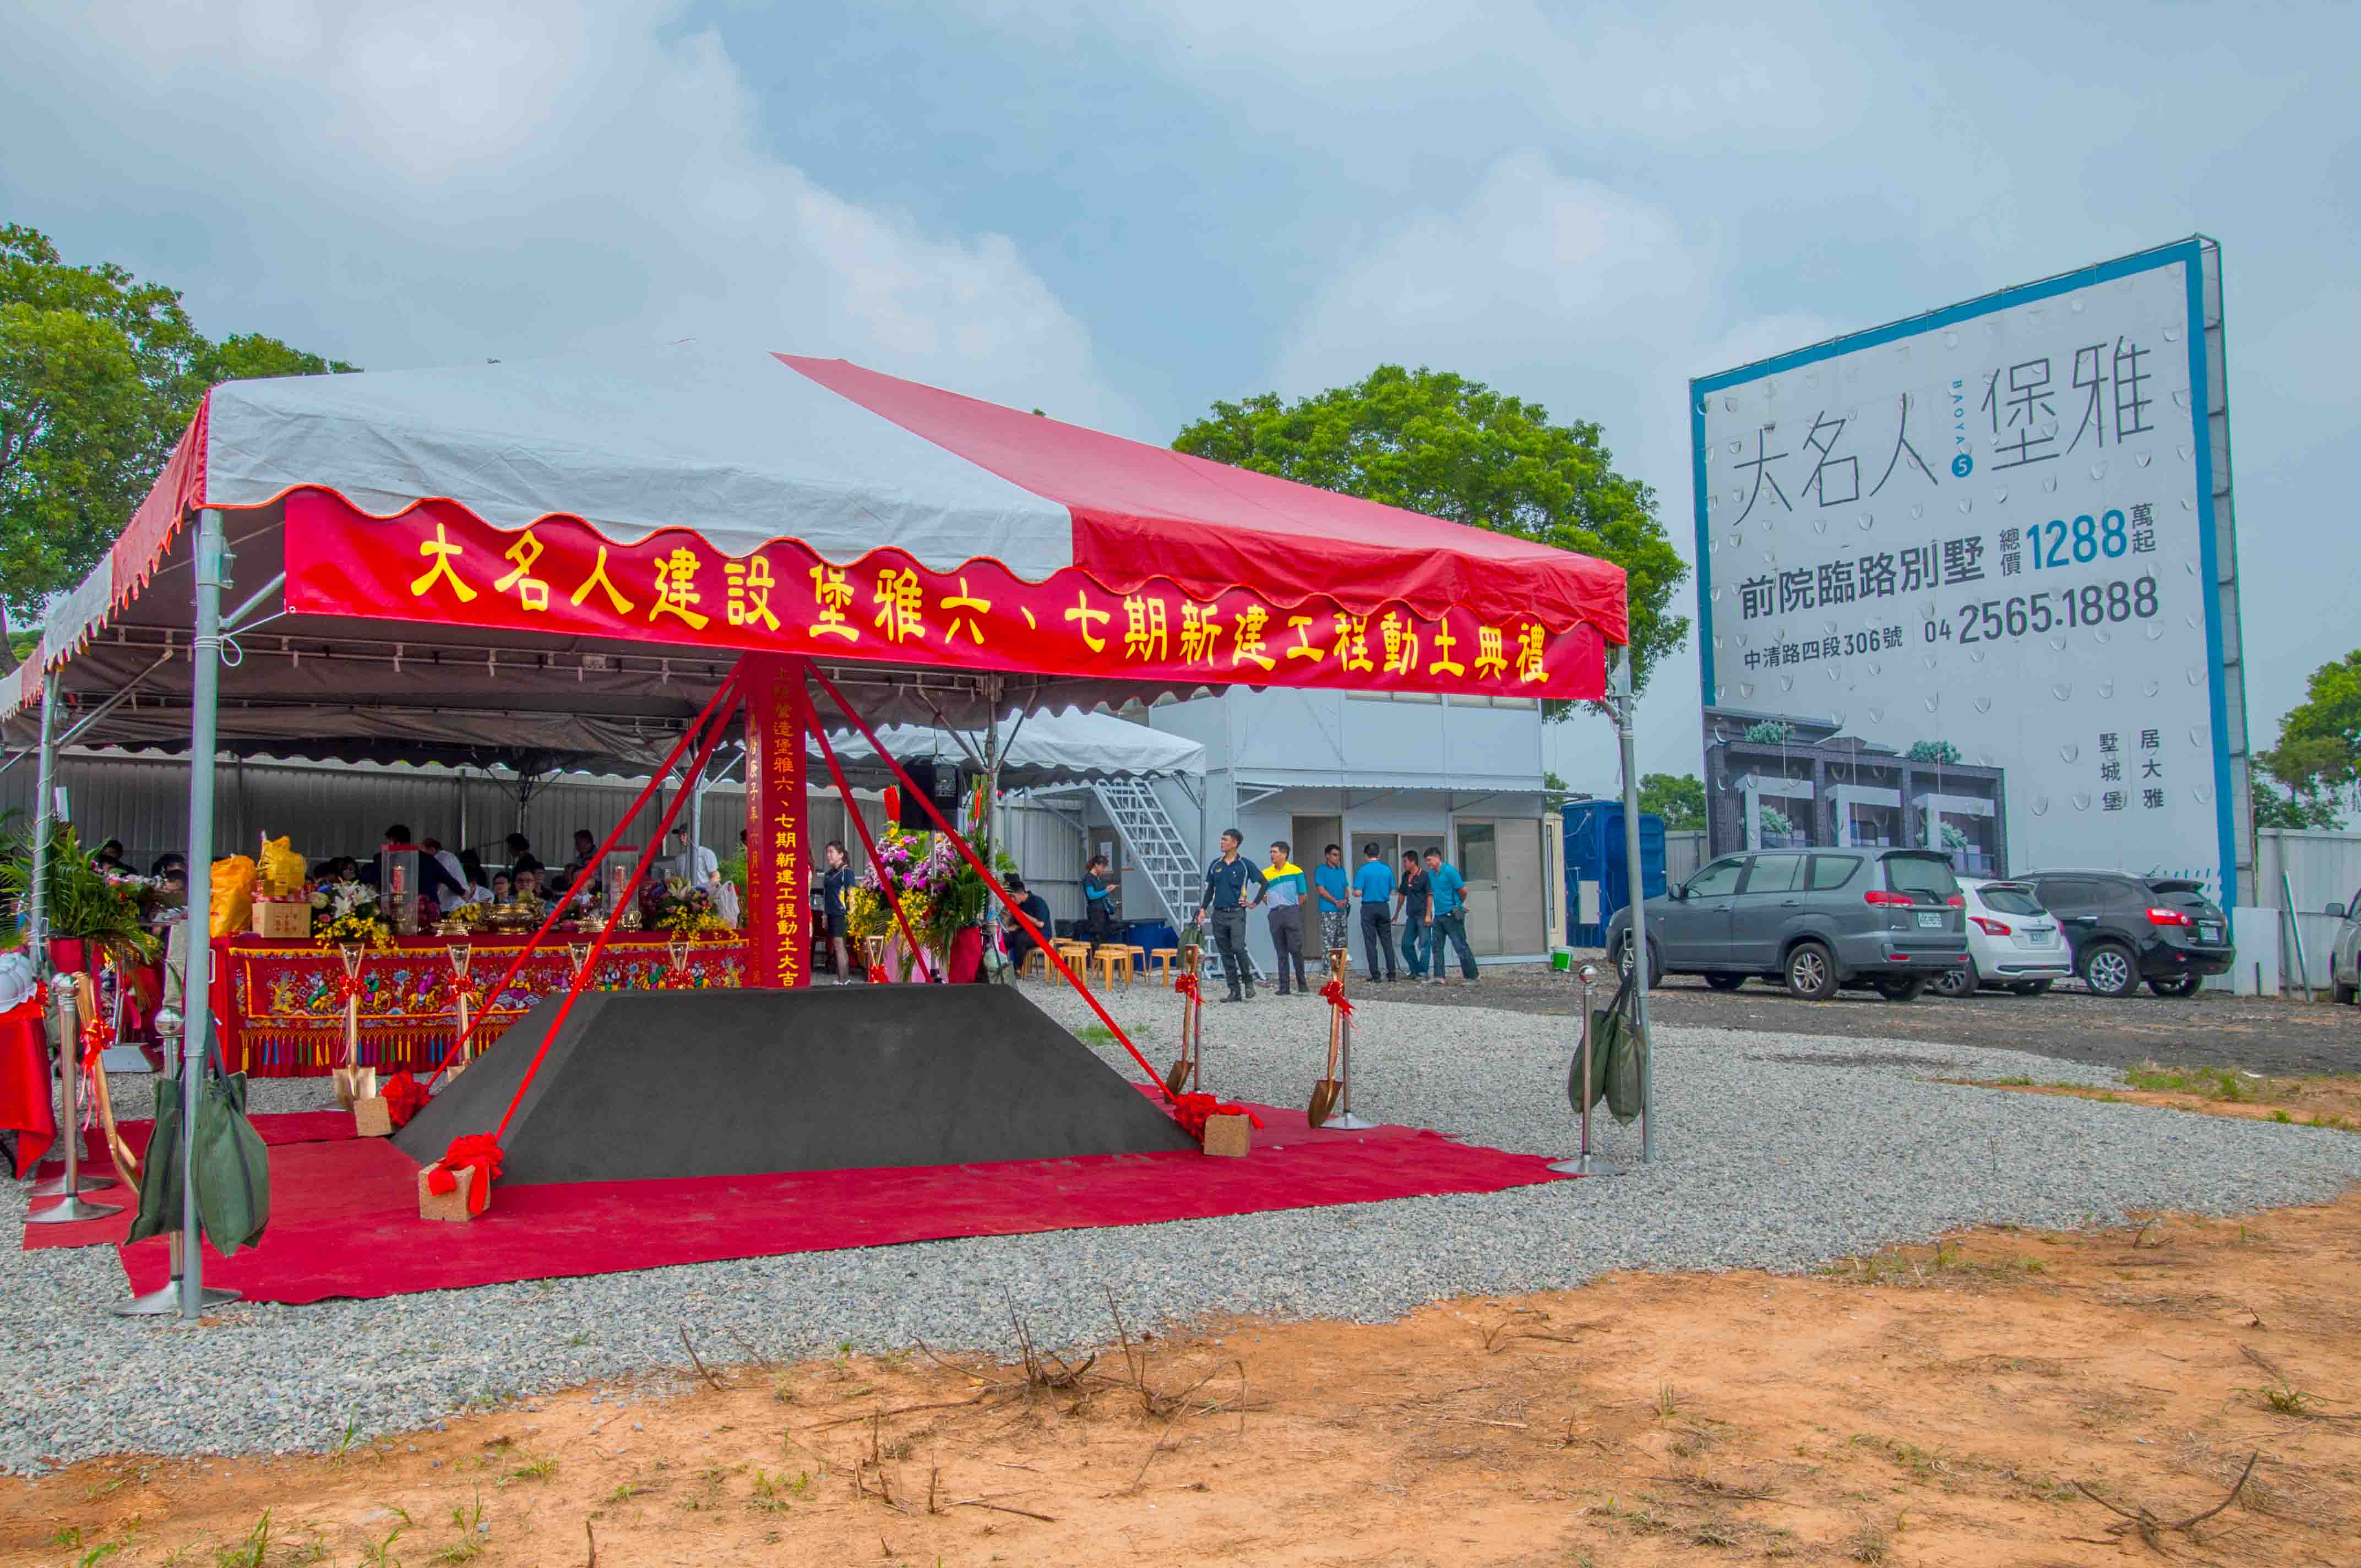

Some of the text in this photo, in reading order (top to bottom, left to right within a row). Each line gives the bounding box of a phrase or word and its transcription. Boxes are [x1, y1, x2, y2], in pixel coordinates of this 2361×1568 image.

[1952, 379, 1966, 445] BAOYA
[1981, 335, 2154, 471] 堡雅
[1733, 393, 1939, 526] 大名人
[1999, 527, 2022, 577] 總價
[2026, 509, 2127, 570] 1288
[2129, 502, 2157, 554] 萬起
[410, 522, 1551, 683] 大名人建設堡雅六、七期新建工程動土典禮
[1740, 535, 1985, 620] 前院臨路別墅
[1924, 576, 2158, 645] 04 2565.1888
[1744, 625, 1903, 671] 中清路四段306號
[2099, 733, 2123, 811] 墅城堡
[2140, 729, 2164, 809] 居大雅
